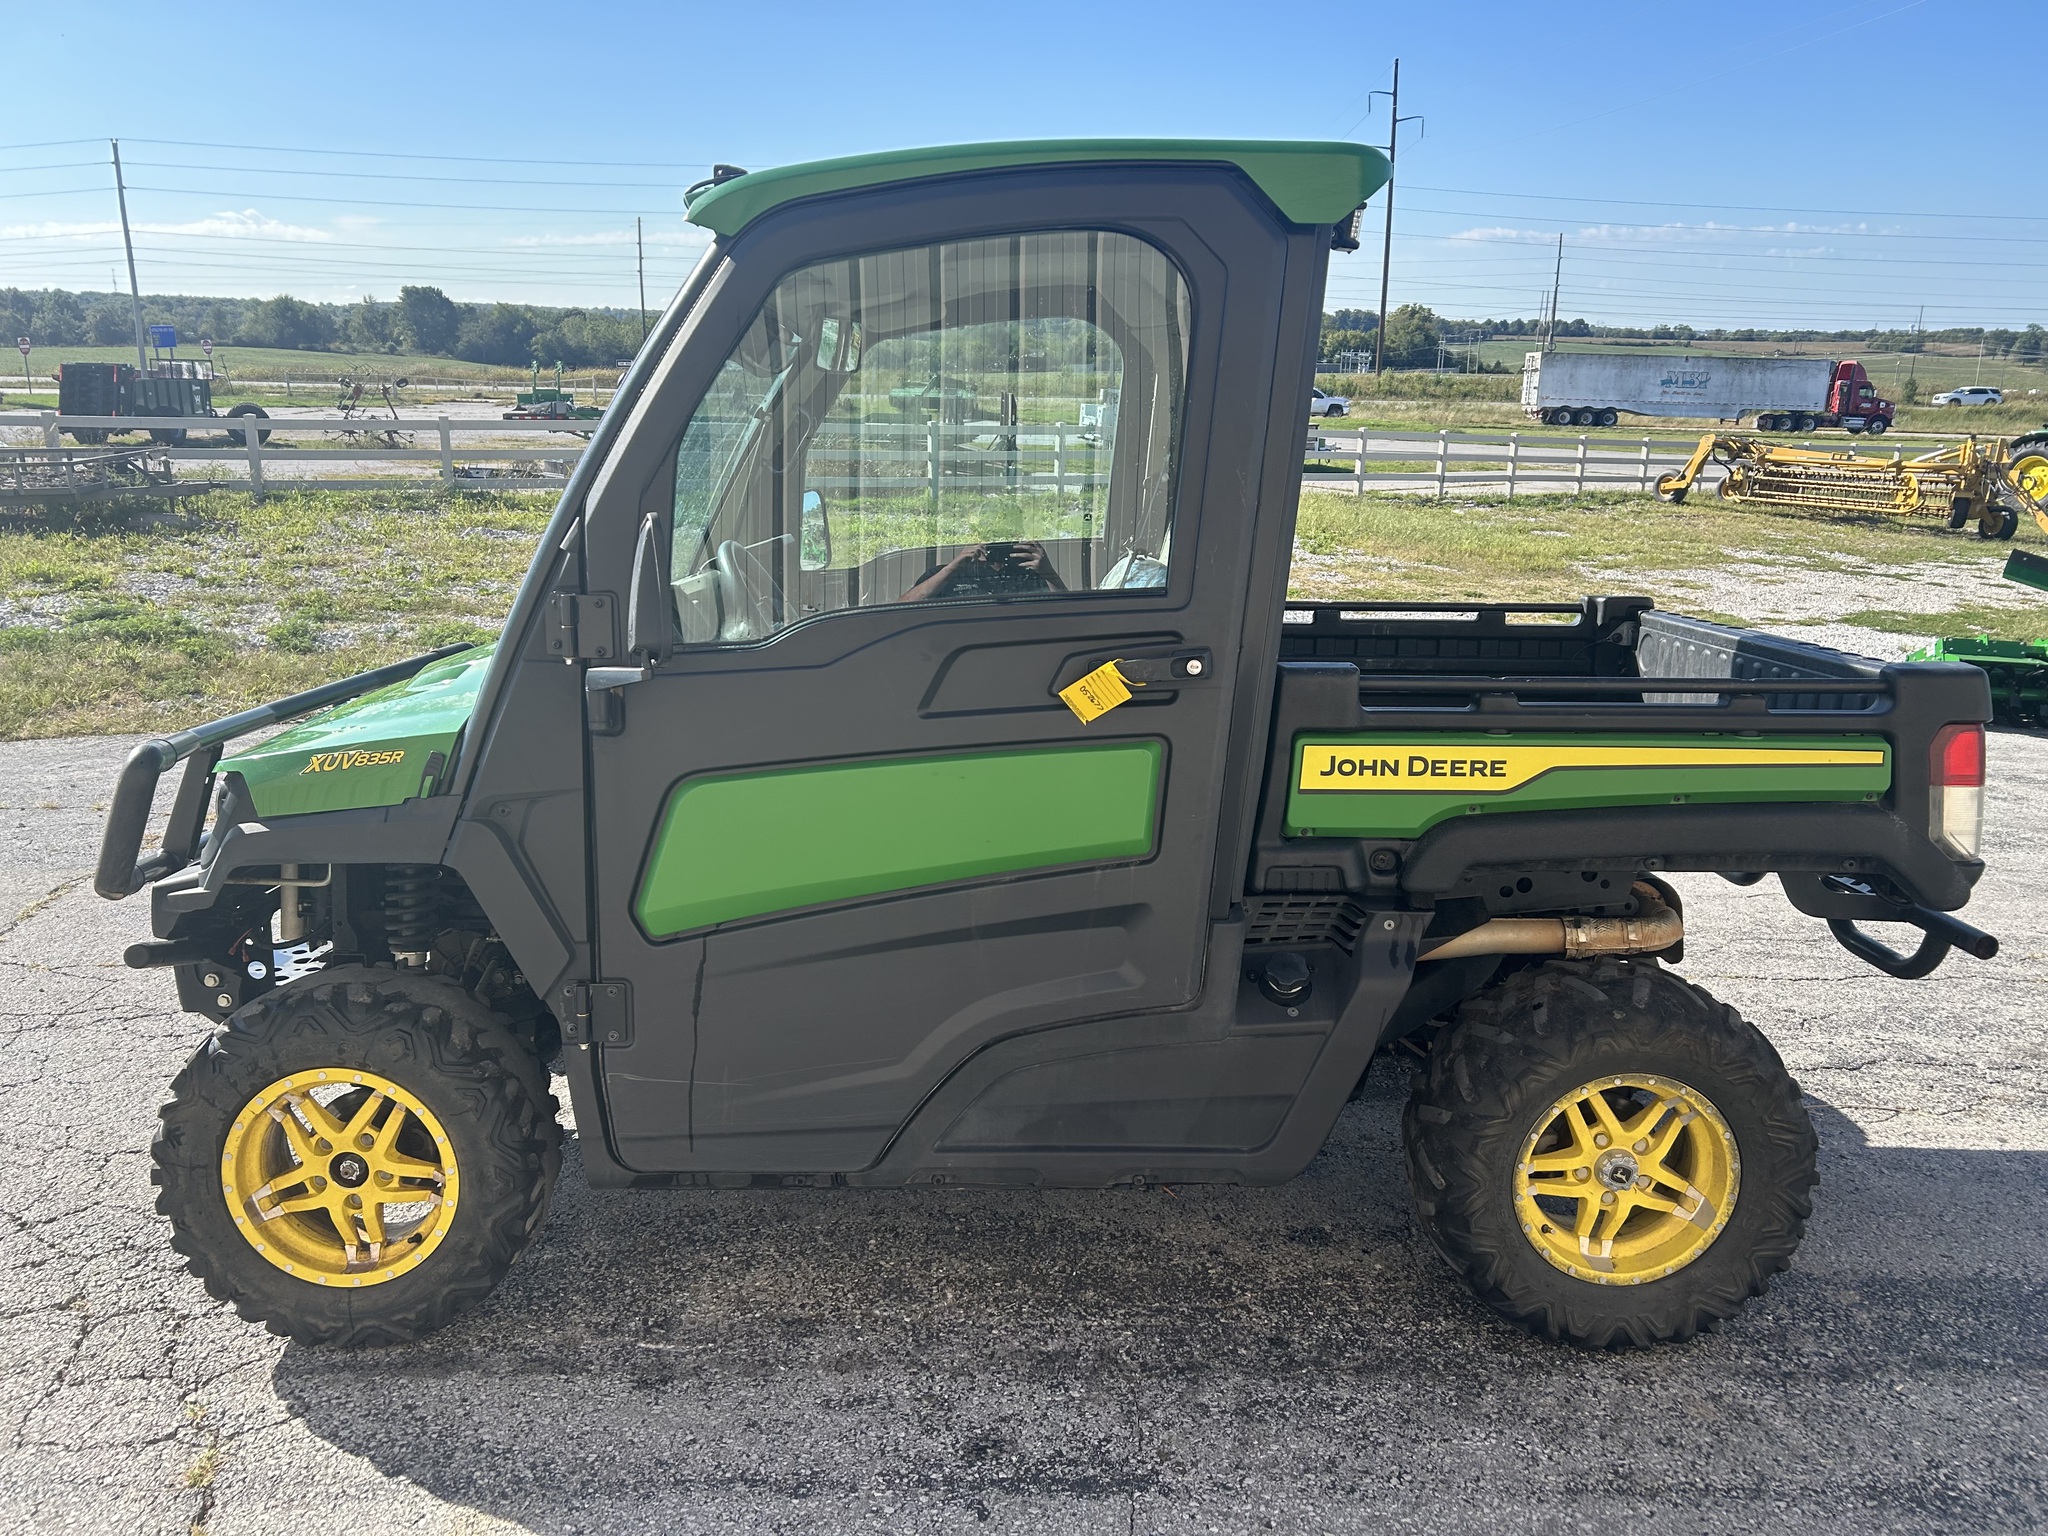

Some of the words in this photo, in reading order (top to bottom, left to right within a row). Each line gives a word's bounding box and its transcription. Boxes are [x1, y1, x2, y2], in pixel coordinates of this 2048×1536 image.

[1664, 370, 1710, 389] MBI
[301, 749, 405, 774] XUV835R
[1320, 755, 1400, 777] JOHN
[1407, 755, 1507, 777] DEERE
